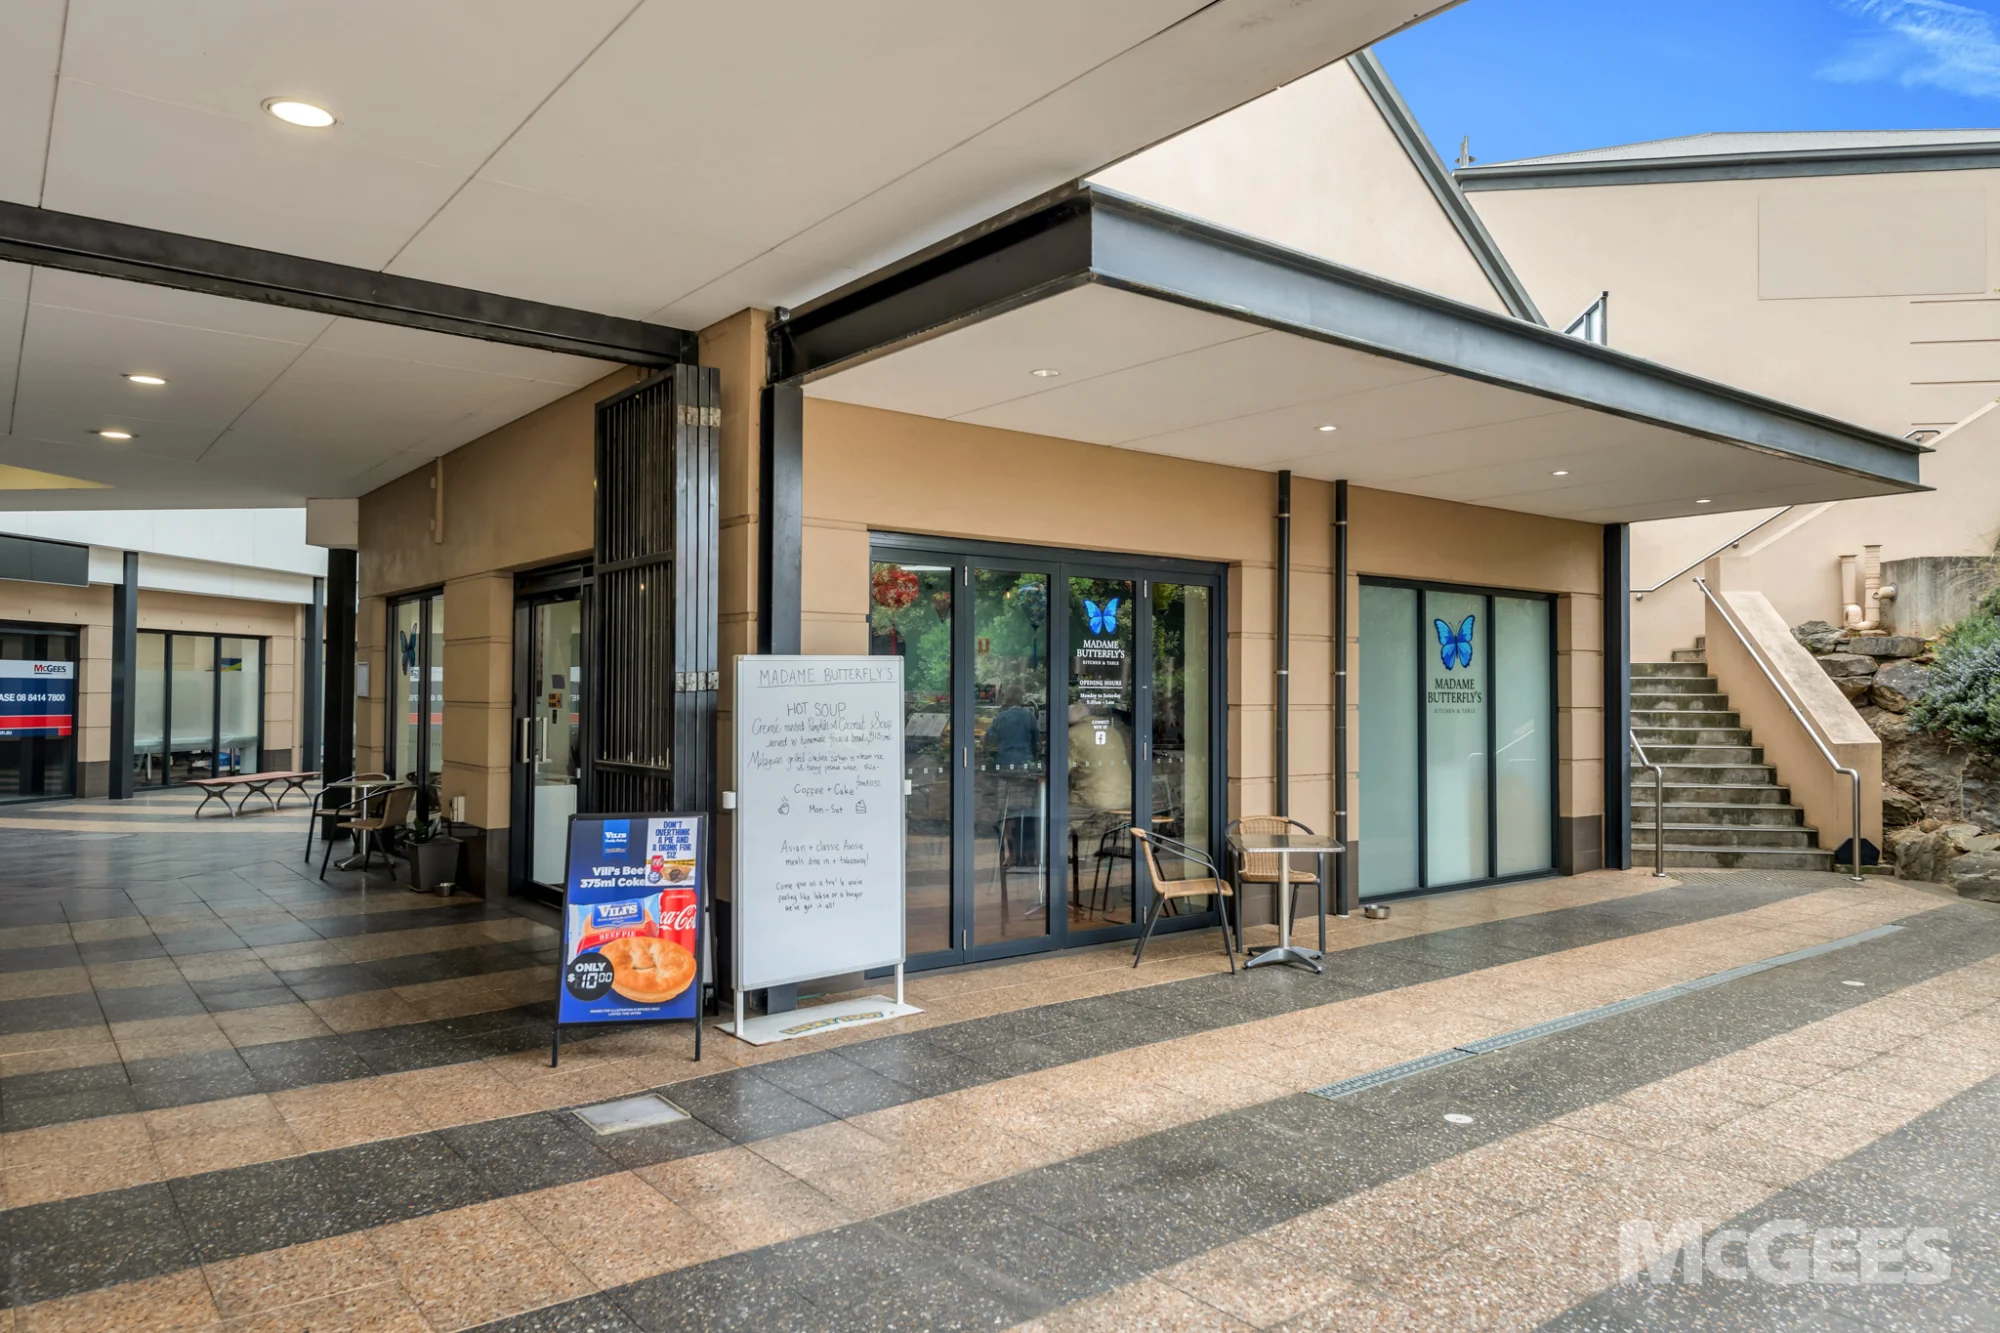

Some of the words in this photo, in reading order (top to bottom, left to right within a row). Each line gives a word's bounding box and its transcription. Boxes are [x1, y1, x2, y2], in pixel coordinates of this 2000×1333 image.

[1083, 640, 1119, 650] MADAME
[1076, 648, 1125, 659] BUTTERFLY'S
[760, 668, 815, 686] MADAME
[824, 667, 894, 683] BUTTERFLY'S
[1434, 678, 1475, 690] MADAME
[16, 693, 26, 702] 08
[27, 693, 46, 702] 8414
[47, 692, 66, 702] 7800
[1080, 692, 1097, 700] Monday
[1427, 690, 1482, 703] BUTTERFLY'S
[787, 702, 808, 717] HOT
[814, 702, 847, 718] SOUP
[794, 783, 824, 797] Coffee
[834, 782, 855, 796] Cake
[663, 820, 683, 829] DON'T
[655, 828, 691, 837] OVERTHINK
[657, 836, 663, 845] A
[664, 836, 675, 844] PIE
[675, 836, 690, 844] AND
[652, 844, 657, 852] A
[658, 844, 679, 852] DRINK
[679, 843, 692, 851] FOR
[780, 839, 806, 854] Asian
[815, 840, 840, 852] classic
[785, 855, 804, 866] meals
[580, 878, 616, 889] 375ml
[775, 881, 793, 891] Come
[600, 932, 621, 941] BEEF
[622, 930, 637, 938] PIE
[574, 962, 607, 973] ONLY
